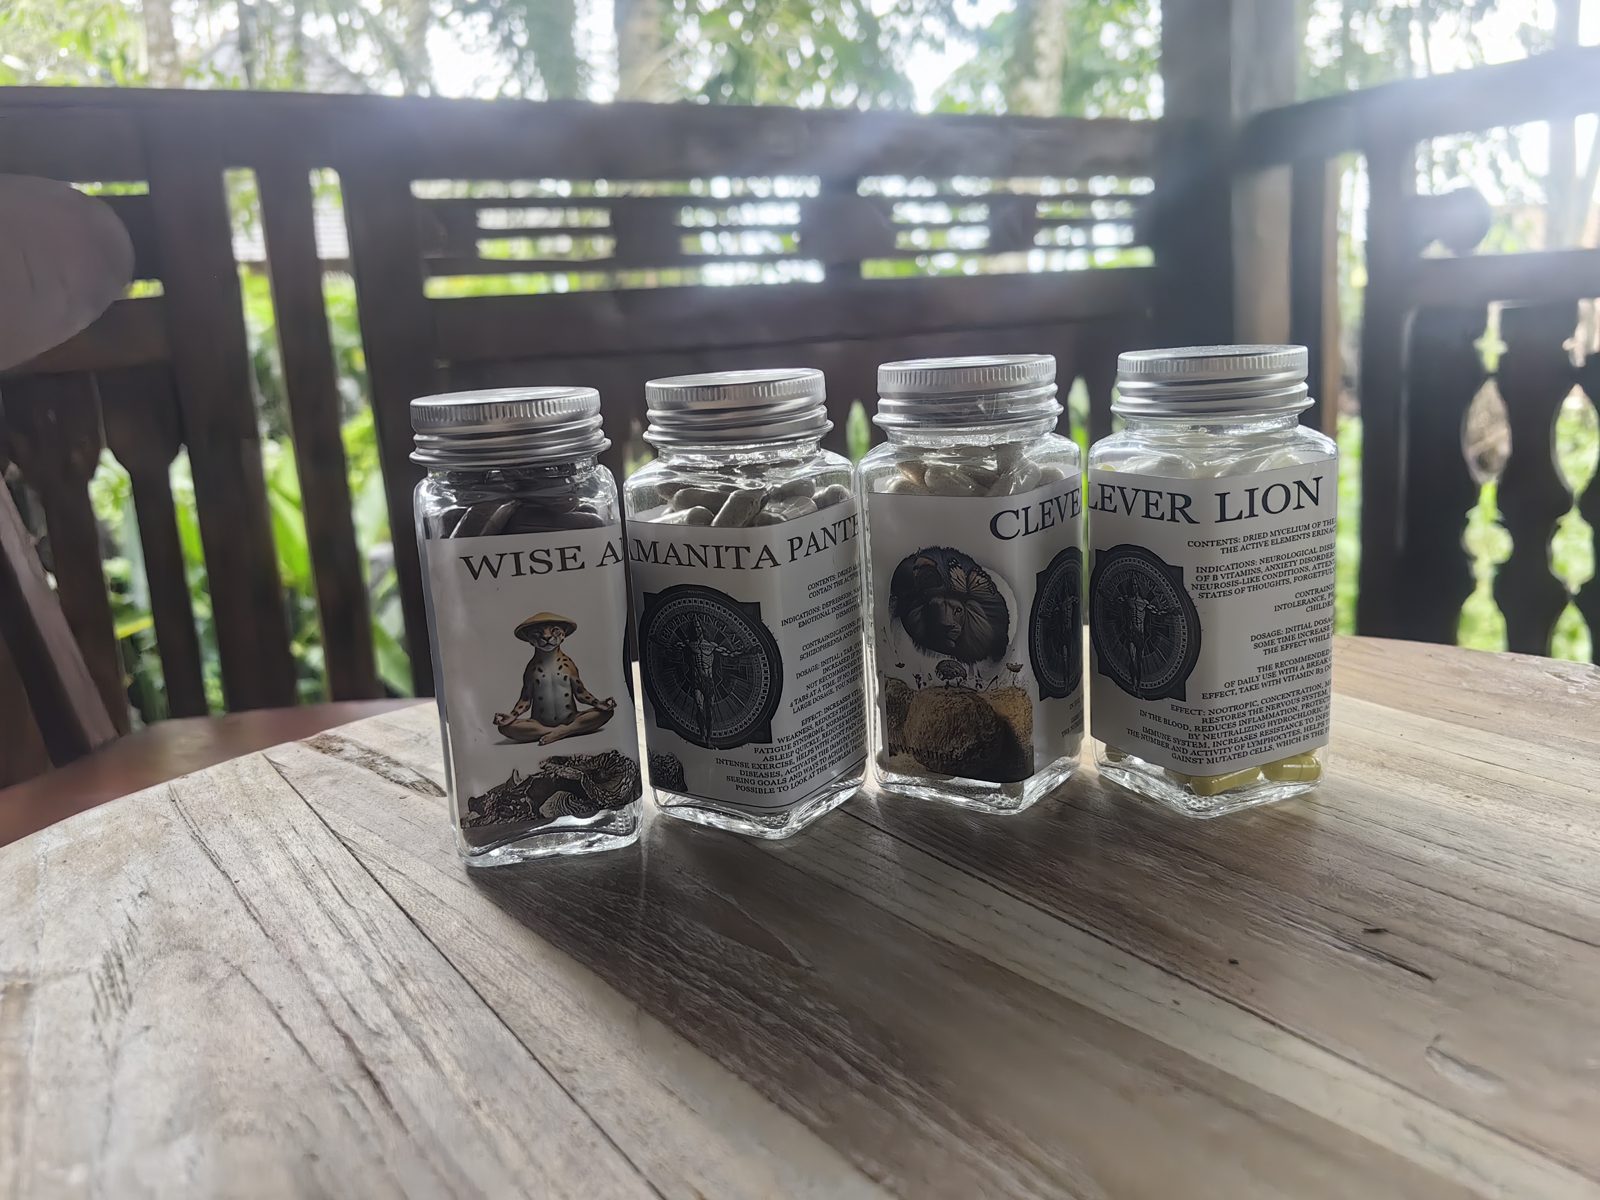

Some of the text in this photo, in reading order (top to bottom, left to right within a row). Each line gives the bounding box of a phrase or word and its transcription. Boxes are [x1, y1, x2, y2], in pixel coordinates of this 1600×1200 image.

[1214, 476, 1323, 524] LION
[989, 488, 1081, 541] CLEVE
[1188, 518, 1335, 548] CONTENTS: DRIED MYCELIUM OF THE
[1220, 546, 1238, 554] THE
[1240, 541, 1270, 552] ACTIVE
[1270, 532, 1310, 546] ELEMENTS
[459, 538, 623, 581] WISE A
[629, 538, 782, 570] MANITA
[1196, 559, 1258, 574] INDICATIONS:
[1259, 547, 1318, 564] NEUROLOGICAL
[1191, 573, 1260, 590] NEUROSIS-LIKE
[1262, 566, 1310, 581] CONDITIONS,
[1312, 559, 1334, 570] ATTEN
[1220, 567, 1262, 580] VITAMINS,
[1264, 560, 1298, 572] ANXIETY
[808, 584, 832, 599] CONTAIN
[1198, 578, 1292, 600] STATES OF THOUGHTS,
[1294, 584, 1334, 599] CONTRAIN
[1274, 594, 1327, 612] INTOLERANCE,
[782, 606, 821, 627] INDICATIONS:
[798, 610, 831, 628] EMOTIONAL
[1250, 630, 1284, 642] DOSAGE:
[1285, 622, 1312, 635] INITIAL
[1254, 625, 1330, 650] SOME TIME INCREASE
[1263, 633, 1330, 656] THE EFFECT WHILE
[800, 637, 842, 661] SCHIZOPHRENIA
[1257, 664, 1273, 673] THE
[1274, 649, 1330, 670] RECOMMENDED
[796, 654, 840, 680] DOSAGE: INITIAL
[1224, 680, 1236, 688] OF
[1237, 675, 1261, 686] DAILY
[1262, 670, 1276, 680] USE
[1278, 664, 1298, 676] WITH
[1306, 658, 1329, 670] BREAK
[806, 680, 818, 691] NOT
[1202, 688, 1238, 700] EFFECT,
[1239, 684, 1260, 694] TAKE
[1261, 678, 1282, 689] WITH
[1283, 670, 1314, 684] VITAMIN
[1315, 667, 1324, 676] B3
[792, 700, 812, 714] LARGE
[794, 693, 808, 705] TABS
[809, 688, 817, 698] AT
[1170, 704, 1206, 716] EFFECT:
[1208, 700, 1260, 716] NOOTROPIC,
[1260, 683, 1324, 705] CONCENTRATION,
[801, 710, 822, 726] EFFECT:
[1140, 708, 1148, 718] IN
[1148, 712, 1162, 722] THE
[1194, 721, 1236, 732] REDUCES
[1238, 706, 1300, 727] INFLAMMATION,
[1188, 732, 1200, 740] BY
[1203, 722, 1266, 740] NEUTRALIZING
[1267, 706, 1324, 728] HYDROCHLORIC
[1202, 710, 1246, 724] RESTORES
[1248, 706, 1264, 716] THE
[1265, 697, 1300, 713] NERVOUS
[1126, 728, 1140, 738] THE
[1140, 733, 1170, 748] NUMBER
[1172, 745, 1188, 754] AND
[1190, 746, 1234, 757] ACTIVITY
[1234, 744, 1246, 752] OF
[1246, 729, 1302, 749] LYMPHOCYTES,
[1304, 722, 1325, 733] HELPS
[1142, 726, 1172, 742] IMMUNE
[1212, 732, 1260, 748] INCREASES
[1260, 720, 1304, 737] RESISTANCE
[1304, 716, 1314, 724] TO
[754, 742, 792, 754] FATIGUE
[763, 750, 794, 762] ASLEEP
[796, 748, 814, 762] HELPS
[814, 740, 830, 751] WITH
[1172, 752, 1204, 764] GAINST
[1206, 750, 1248, 765] MUTATED
[1250, 744, 1275, 756] CELLS,
[1276, 736, 1302, 748] WHICH
[1310, 729, 1324, 738] THE
[757, 778, 786, 786] GOALS
[788, 772, 802, 782] AND
[803, 761, 818, 774] WAYS
[784, 754, 818, 776] ACTIVATES
[818, 746, 829, 758] THE
[736, 784, 776, 794] POSSIBLE
[790, 776, 808, 790] LOOK
[808, 770, 816, 780] AT
[816, 764, 828, 774] THE
